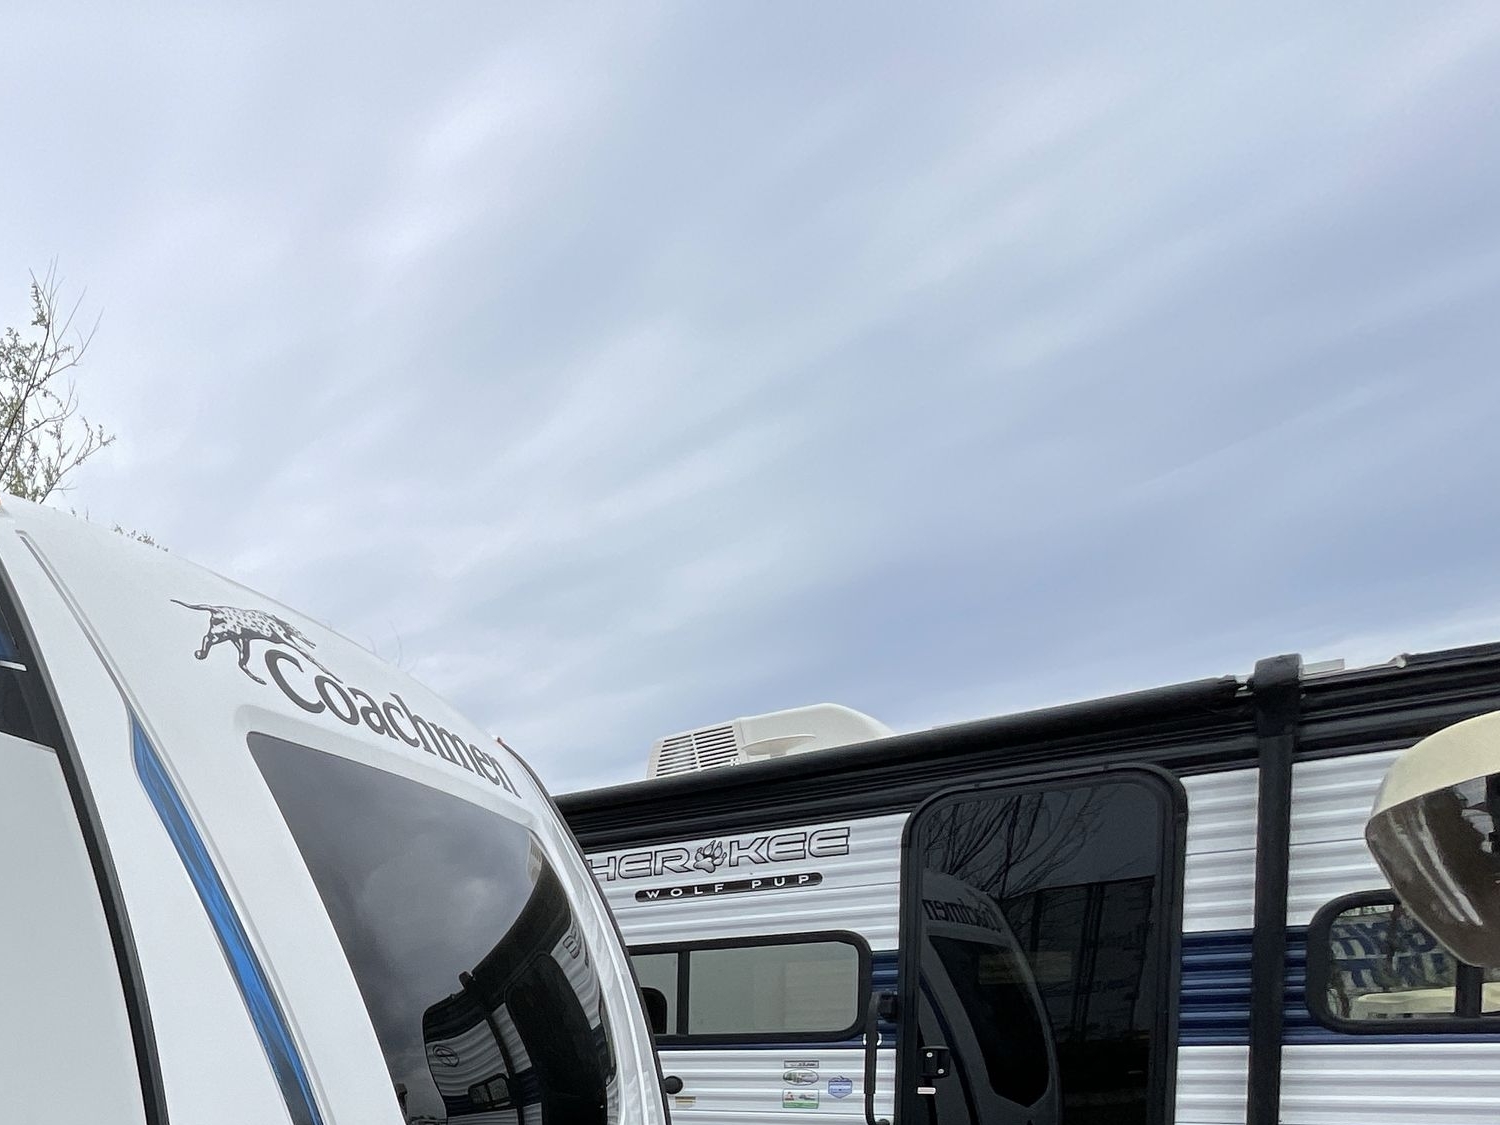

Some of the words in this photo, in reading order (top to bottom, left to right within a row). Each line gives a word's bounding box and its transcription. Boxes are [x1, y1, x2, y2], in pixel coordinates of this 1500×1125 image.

[264, 649, 522, 799] Coachmen
[646, 883, 725, 899] WOLF
[751, 874, 811, 889] PUP
